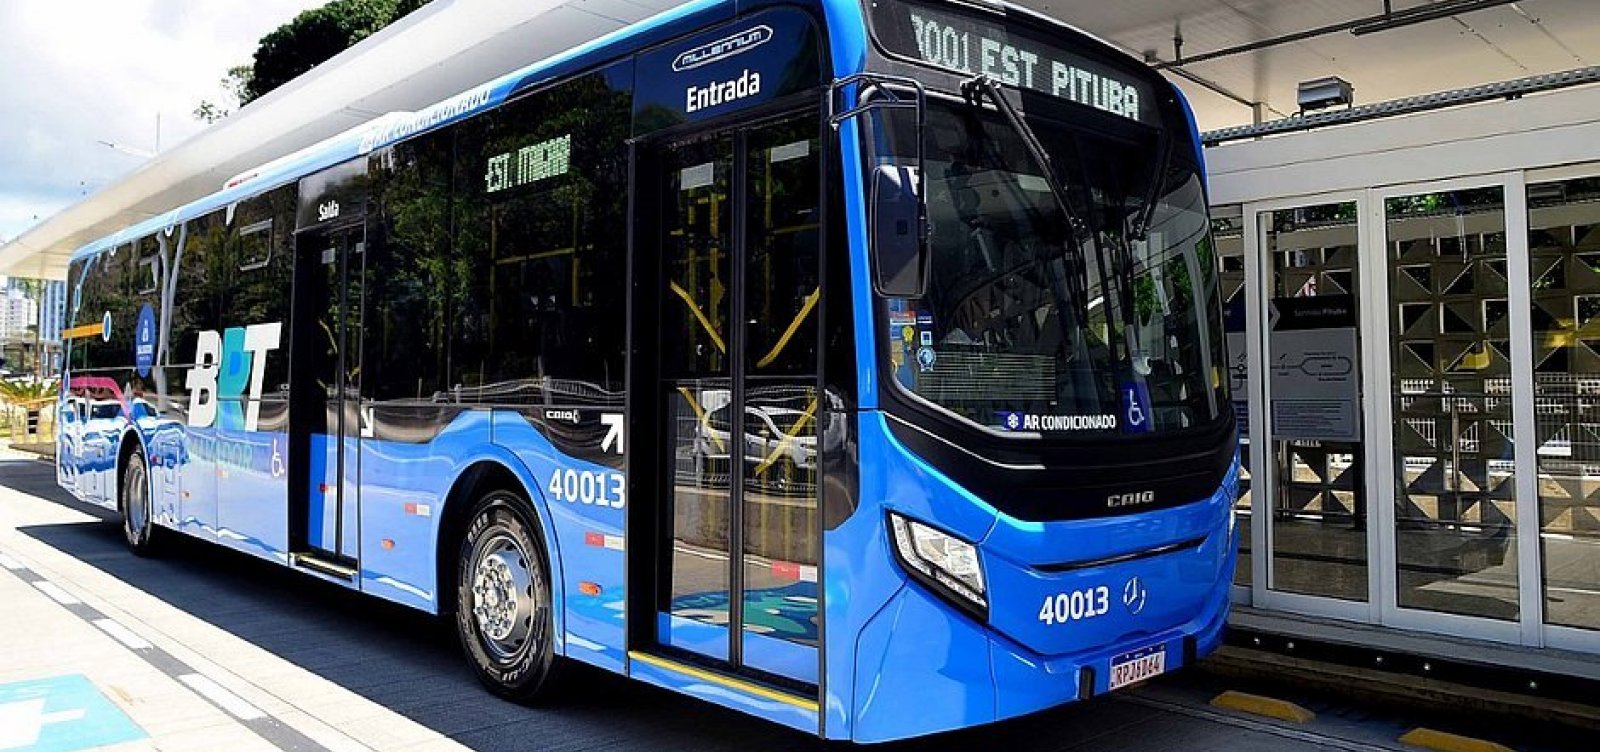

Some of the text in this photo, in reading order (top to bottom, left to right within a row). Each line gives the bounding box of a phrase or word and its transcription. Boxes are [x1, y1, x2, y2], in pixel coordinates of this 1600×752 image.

[686, 69, 760, 112] Entrada
[981, 37, 1038, 88] EST
[1052, 61, 1139, 121] PITUBA
[185, 322, 282, 432] BRT
[1024, 414, 1117, 431] AR CONDICIONADO
[549, 468, 626, 509] 40013
[1107, 490, 1155, 507] CAIO
[1039, 586, 1109, 625] 40013
